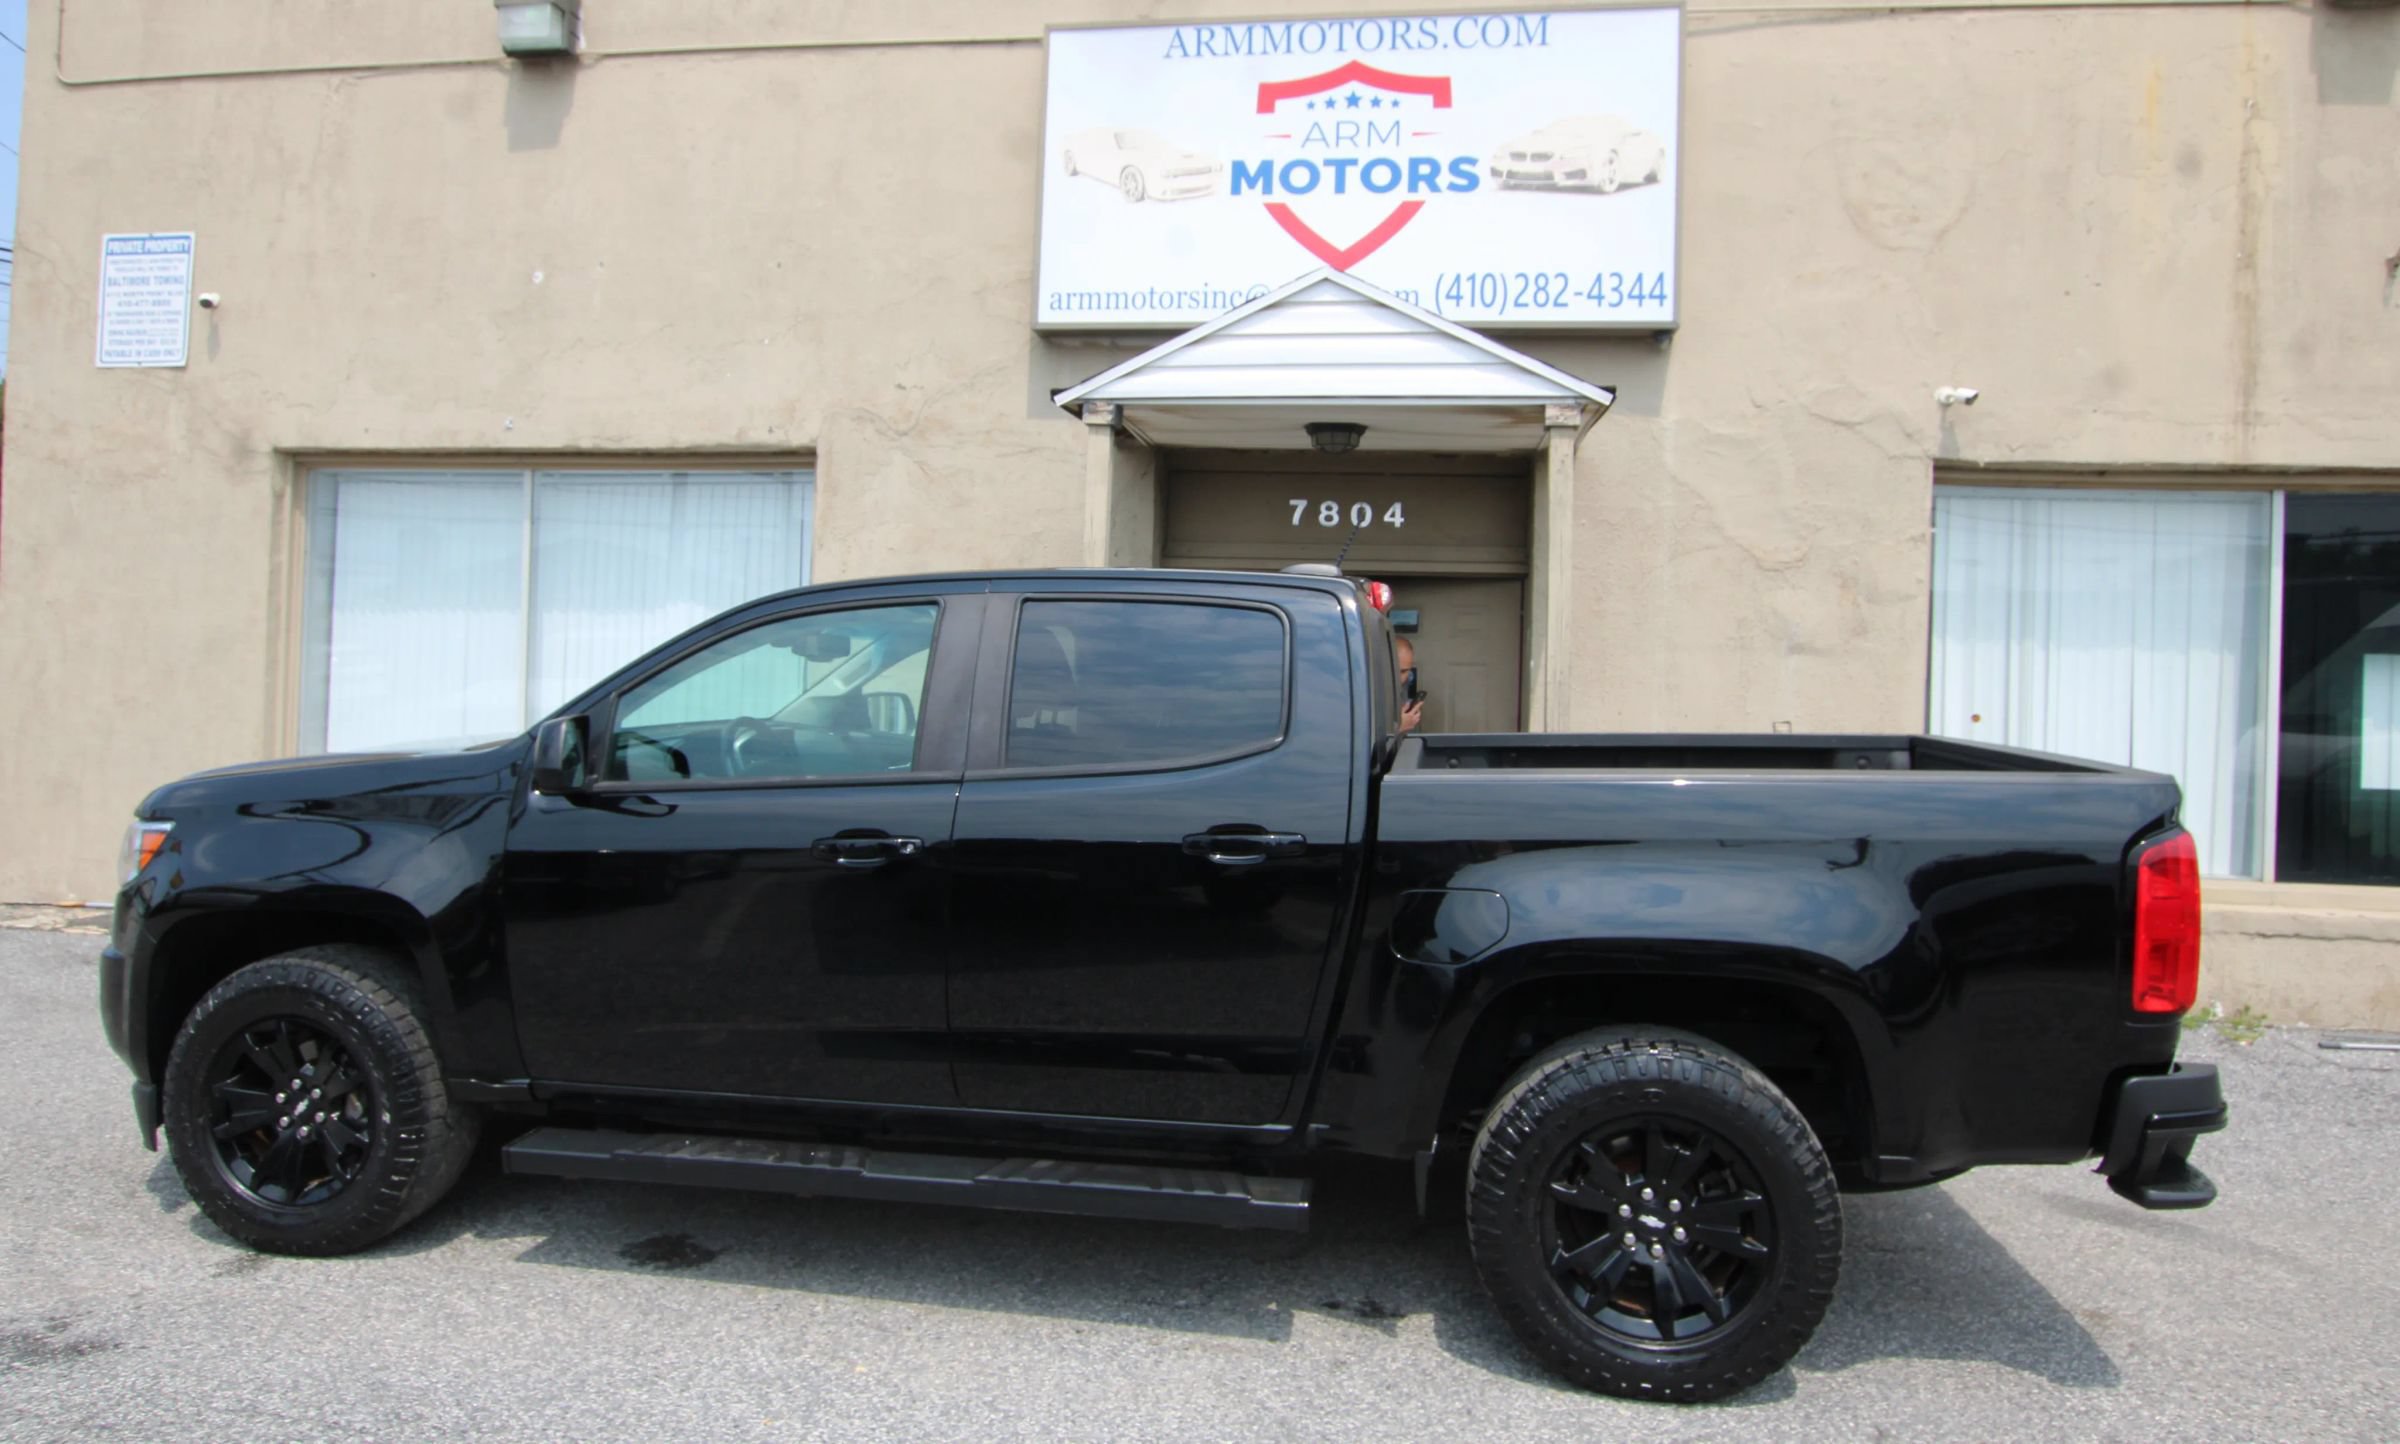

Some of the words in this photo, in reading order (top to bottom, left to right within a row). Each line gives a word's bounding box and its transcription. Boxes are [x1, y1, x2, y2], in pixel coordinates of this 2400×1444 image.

[1163, 14, 1551, 58] ARMMOTORS.COM
[1301, 120, 1401, 149] ARM
[1230, 156, 1480, 196] MOTORS
[107, 240, 143, 253] PRIVATE
[145, 239, 189, 252] PROPERTY
[108, 275, 150, 287] BALTIMORE
[153, 275, 184, 286] TOWING
[1435, 271, 1667, 315] (410)282-4344
[1288, 498, 1405, 529] 7804
